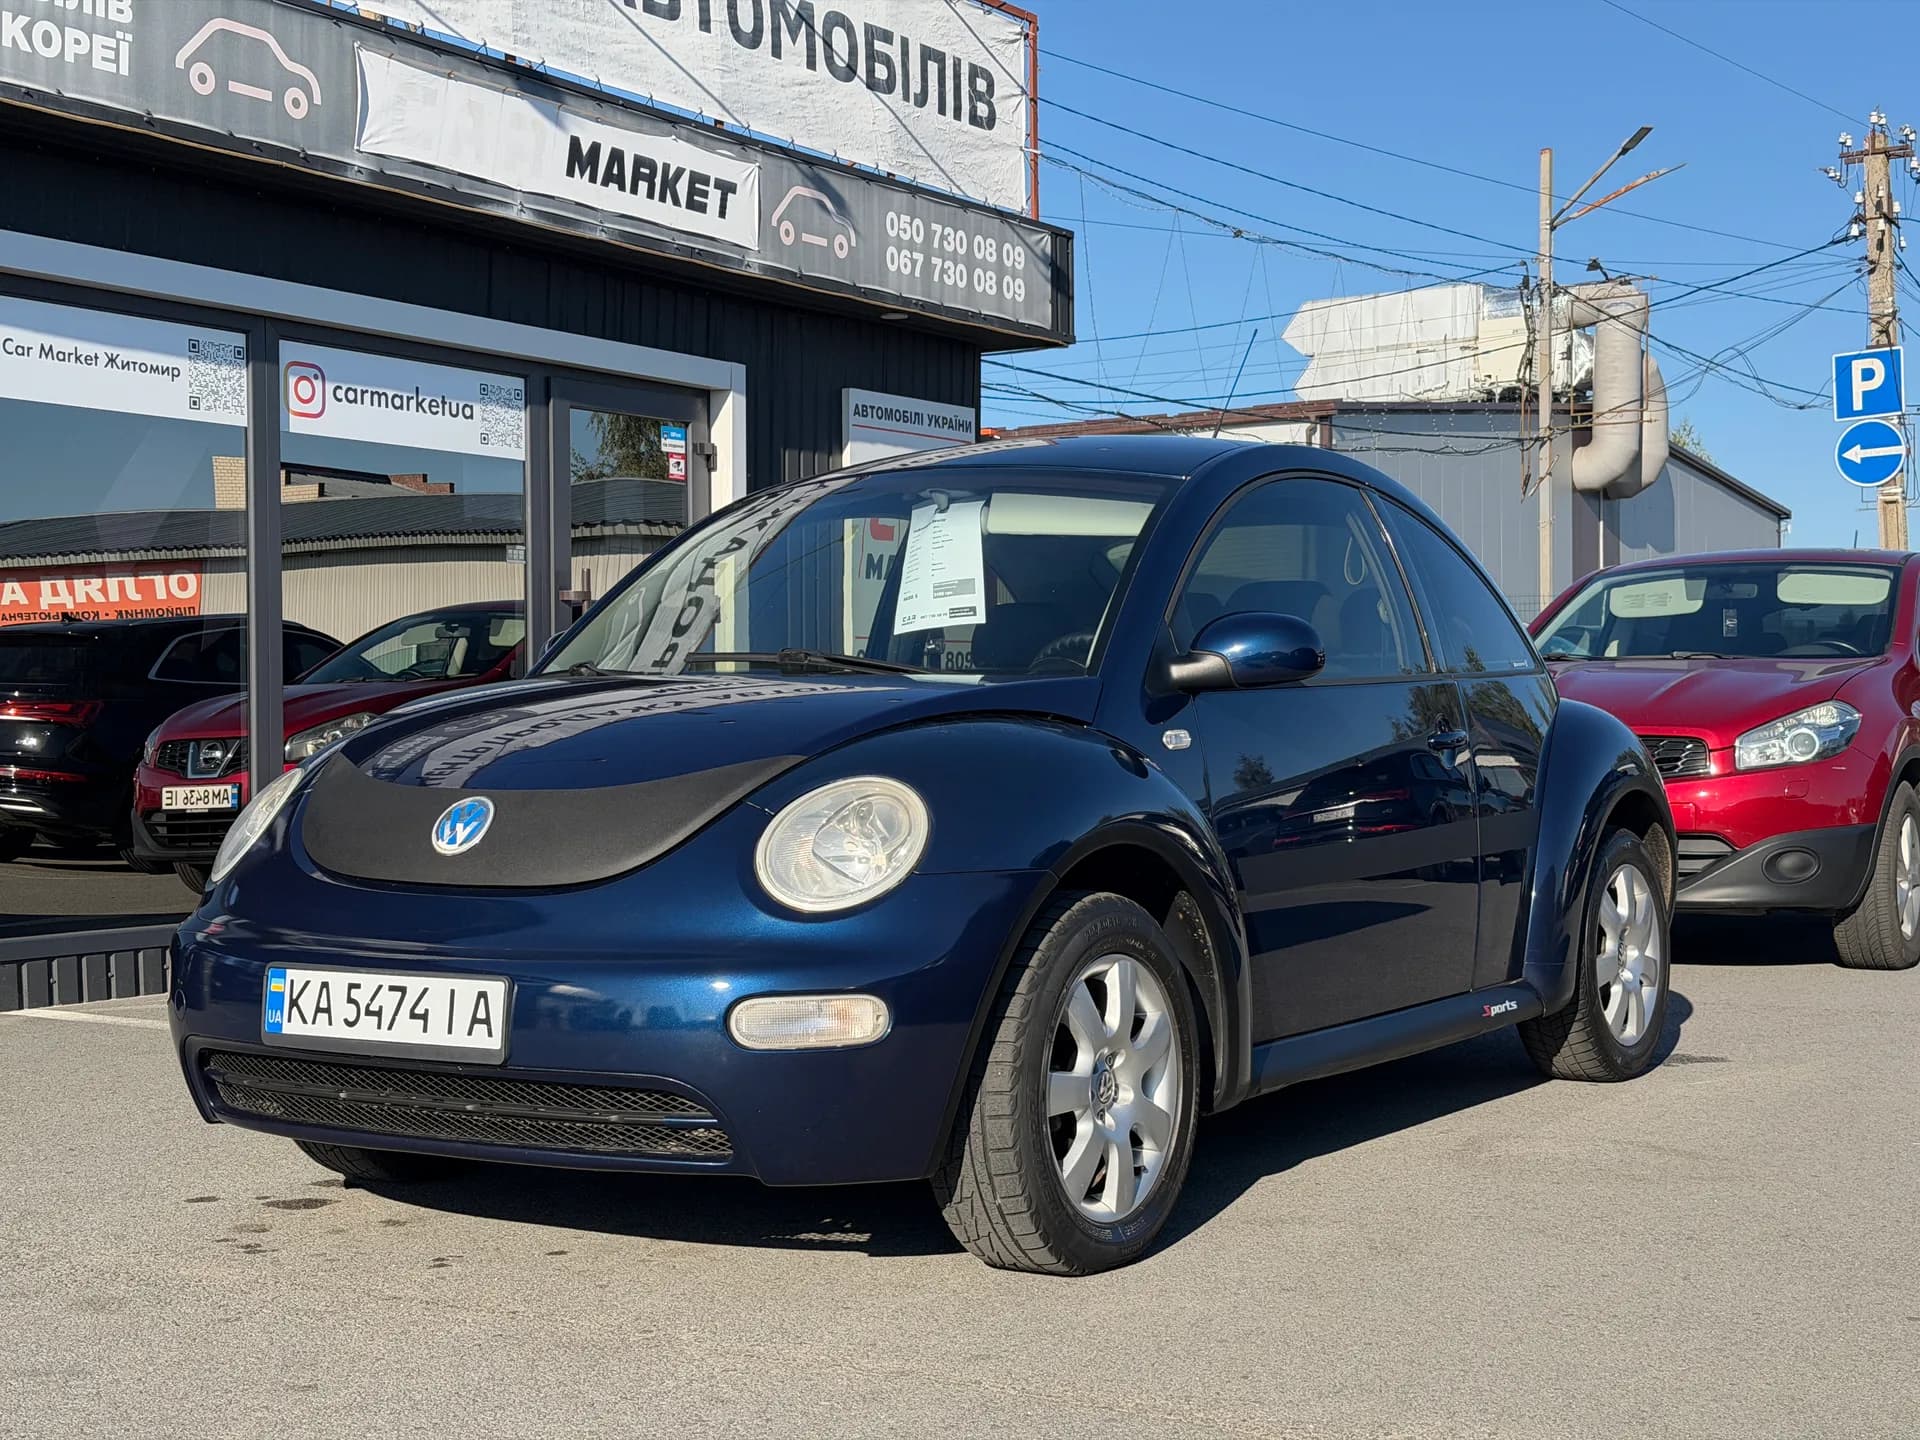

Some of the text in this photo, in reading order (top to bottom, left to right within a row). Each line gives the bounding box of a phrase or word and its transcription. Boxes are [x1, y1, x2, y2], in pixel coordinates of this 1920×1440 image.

[2, 11, 133, 77] КОРЕЇ
[624, 0, 997, 131] ОМОБІЛІВ
[565, 134, 738, 220] MARKET
[886, 211, 1025, 271] 050 730 08 09
[886, 246, 1025, 302] 067 730 08 09
[2, 337, 181, 382] Car Market Житомир
[1851, 358, 1885, 411] P
[333, 386, 475, 420] carmarketua
[853, 403, 972, 434] АВТОМОБІЛІ УКРАЇНИ
[268, 1008, 282, 1024] UA
[287, 979, 333, 1026] KA
[343, 982, 430, 1034] 5474
[1482, 1000, 1518, 1017] Sports
